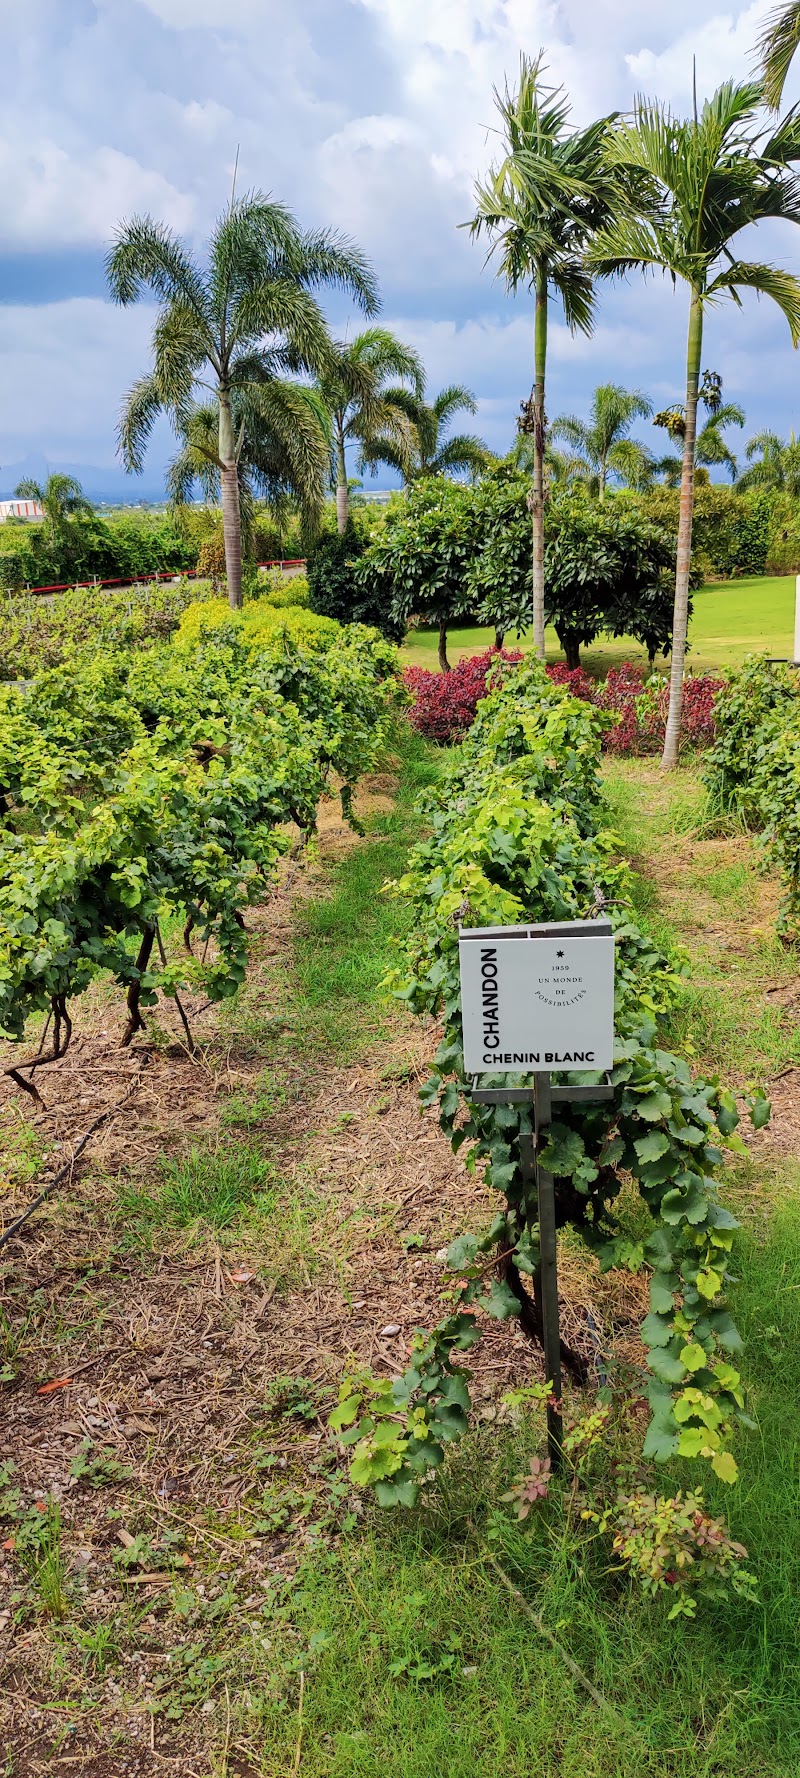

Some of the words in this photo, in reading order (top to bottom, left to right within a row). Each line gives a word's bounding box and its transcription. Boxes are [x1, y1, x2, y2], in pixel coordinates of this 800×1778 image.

[480, 948, 500, 1049] CHANDON
[482, 1052, 540, 1064] CHENIN
[544, 1051, 595, 1063] BLANC
